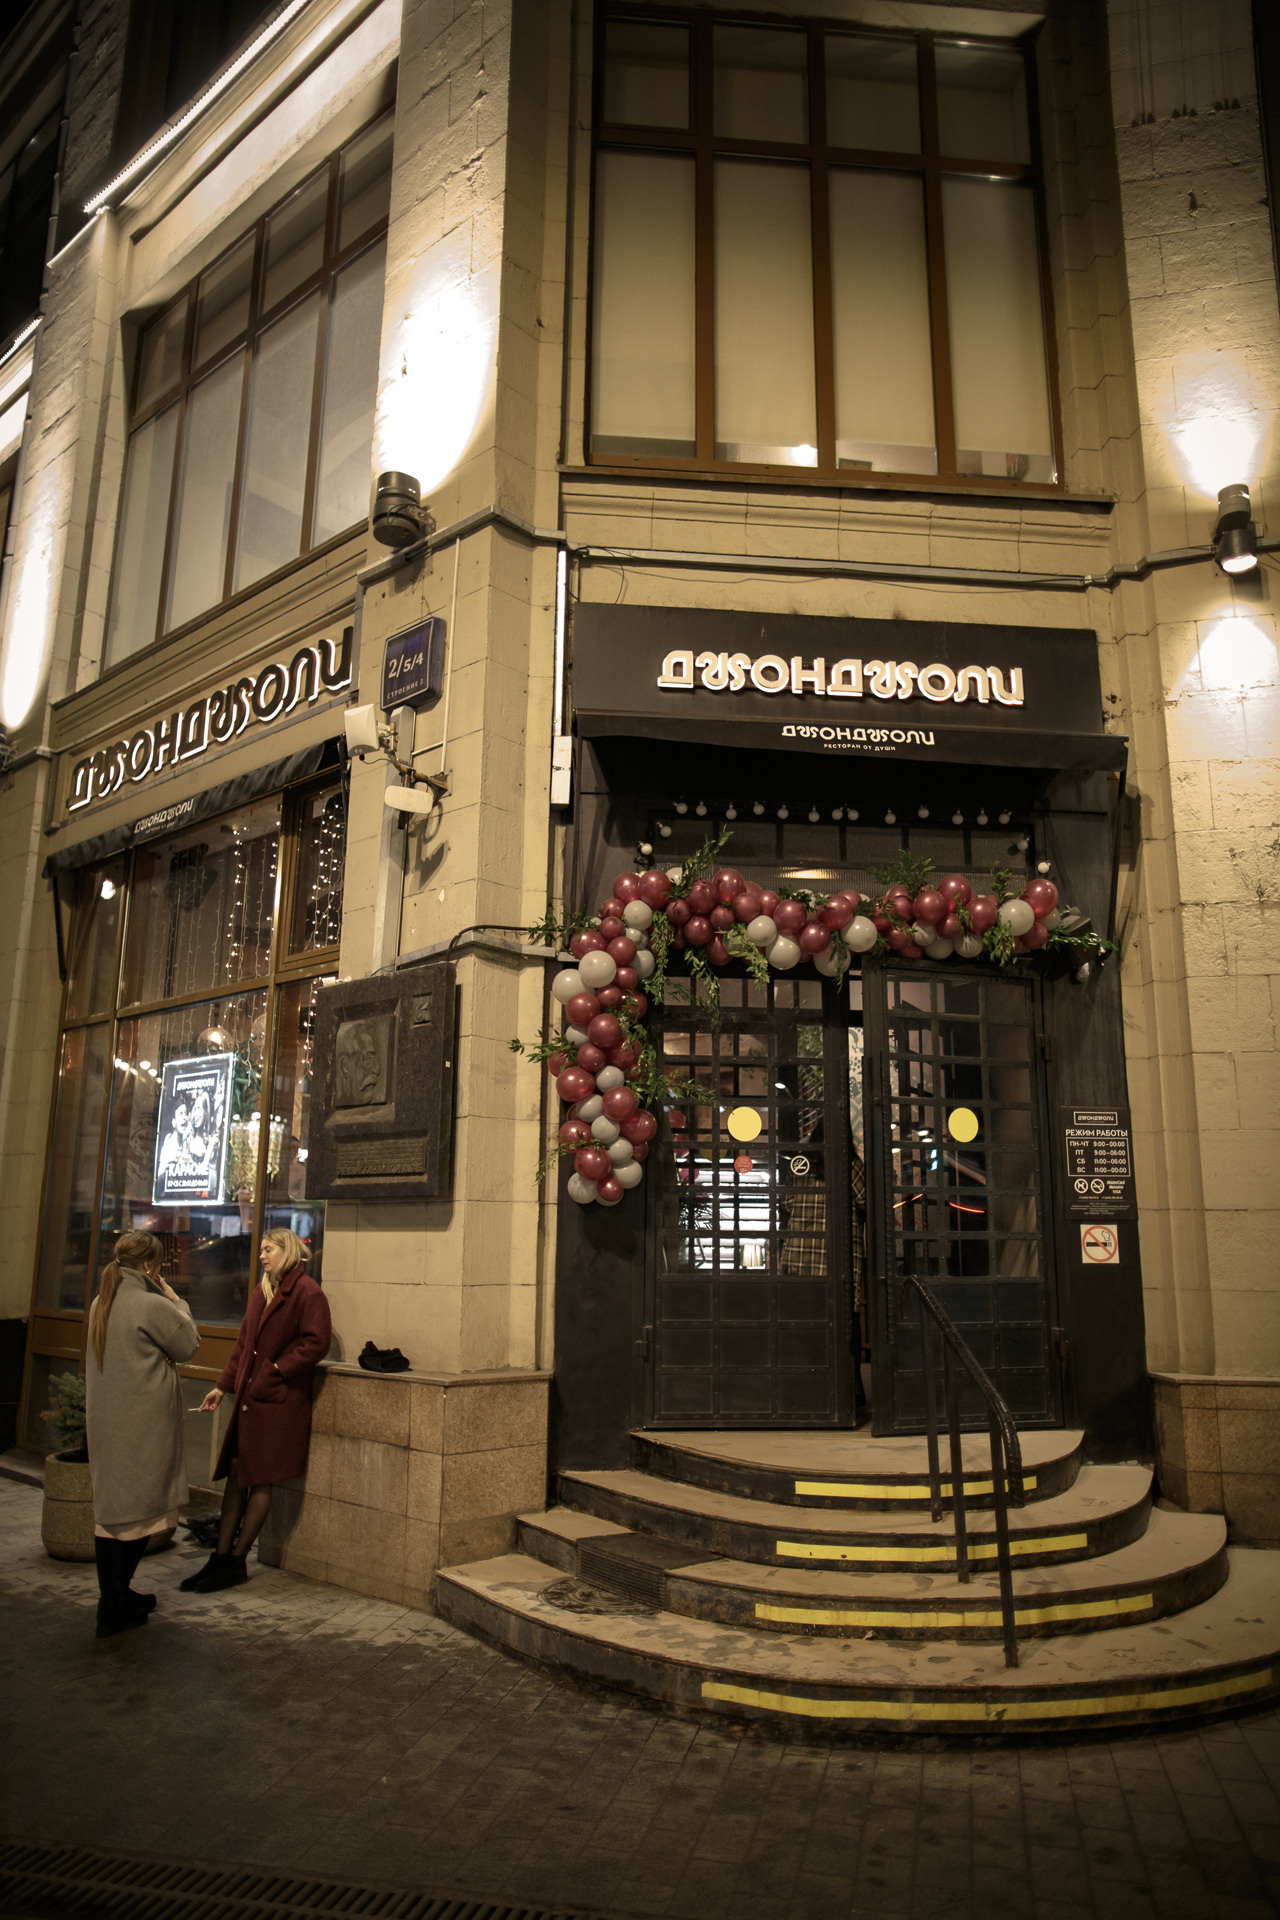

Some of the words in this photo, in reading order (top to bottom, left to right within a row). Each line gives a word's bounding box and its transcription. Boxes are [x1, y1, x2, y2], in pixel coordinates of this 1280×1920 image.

[388, 652, 424, 679] 2/5/4
[387, 680, 419, 699] СТРОЕНИЕ
[1096, 1129, 1128, 1137] РАБОТЫ
